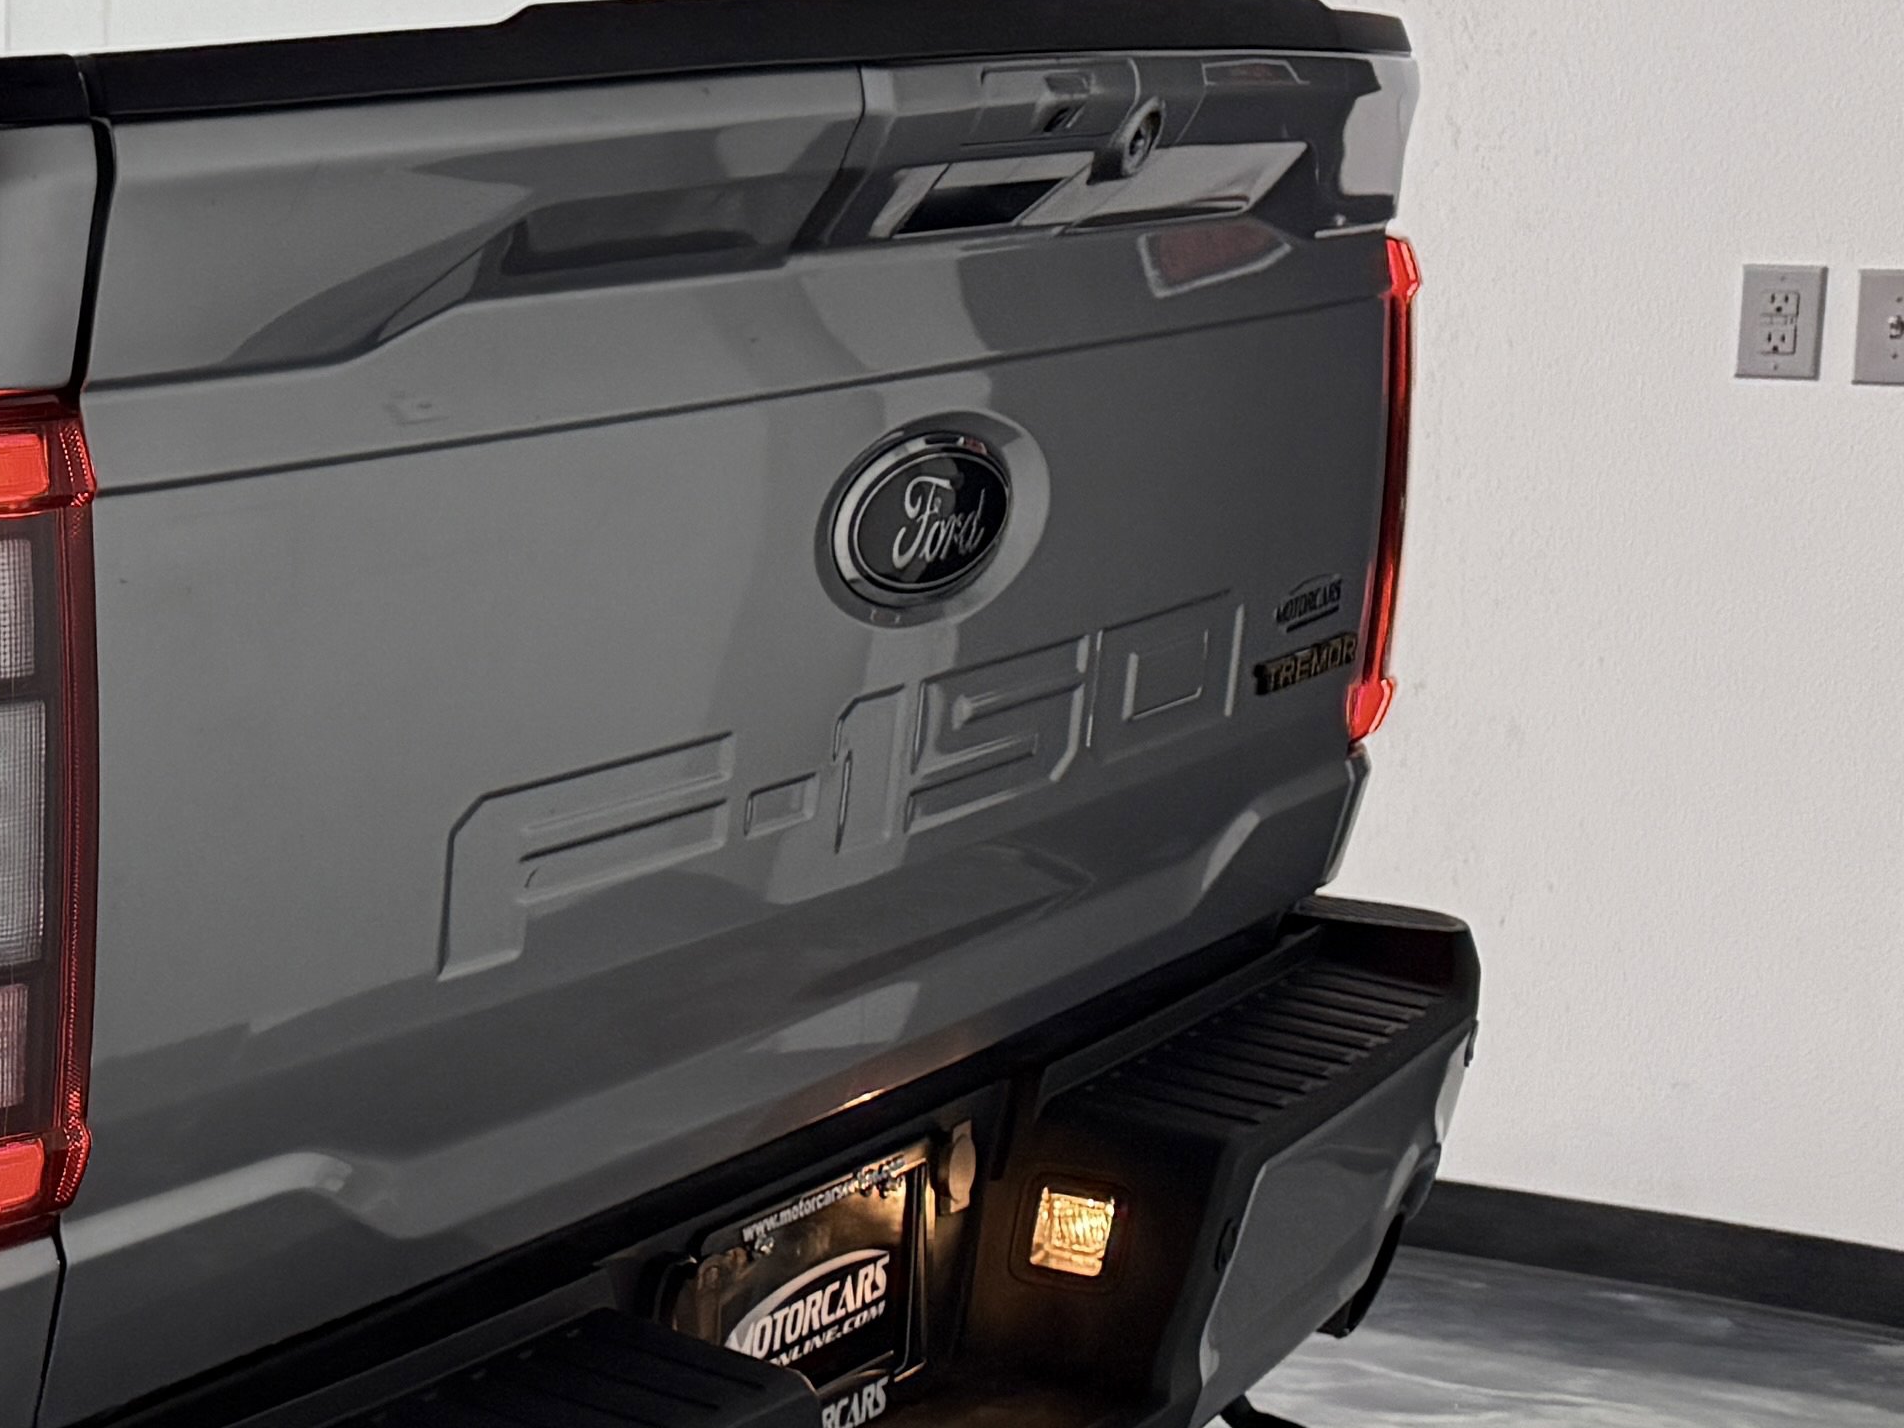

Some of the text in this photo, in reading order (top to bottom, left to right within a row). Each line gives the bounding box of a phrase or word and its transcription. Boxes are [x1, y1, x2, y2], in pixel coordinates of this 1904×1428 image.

[892, 476, 986, 570] Ford
[1263, 631, 1358, 692] TREMOR
[437, 587, 1245, 981] F-150
[724, 1252, 891, 1360] MOTORCARS
